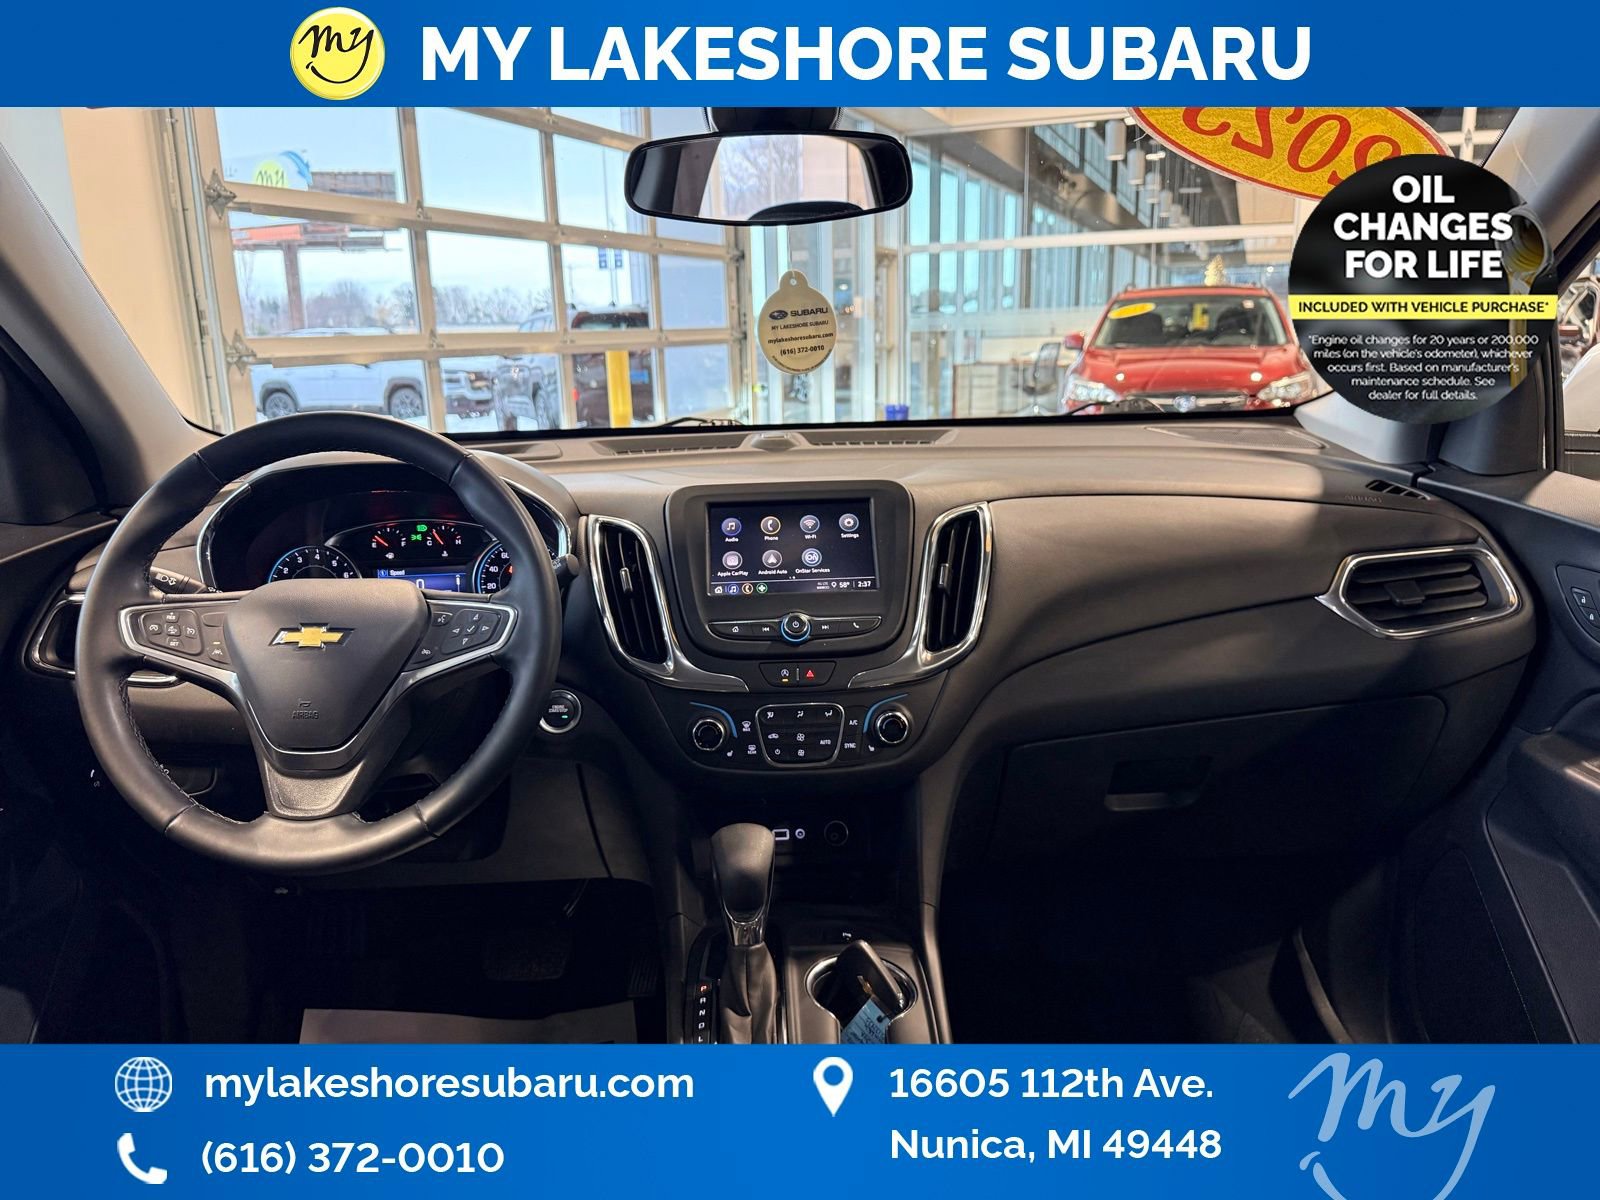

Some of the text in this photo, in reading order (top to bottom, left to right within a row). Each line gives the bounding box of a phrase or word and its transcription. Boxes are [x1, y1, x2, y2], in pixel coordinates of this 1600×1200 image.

[790, 307, 828, 317] SUBARU
[780, 345, 825, 356] (616) 372-0010
[297, 556, 303, 564] 3
[314, 553, 320, 561] 4
[331, 559, 337, 567] 5
[291, 709, 319, 719] AIRBAG
[844, 741, 857, 749] SYNC
